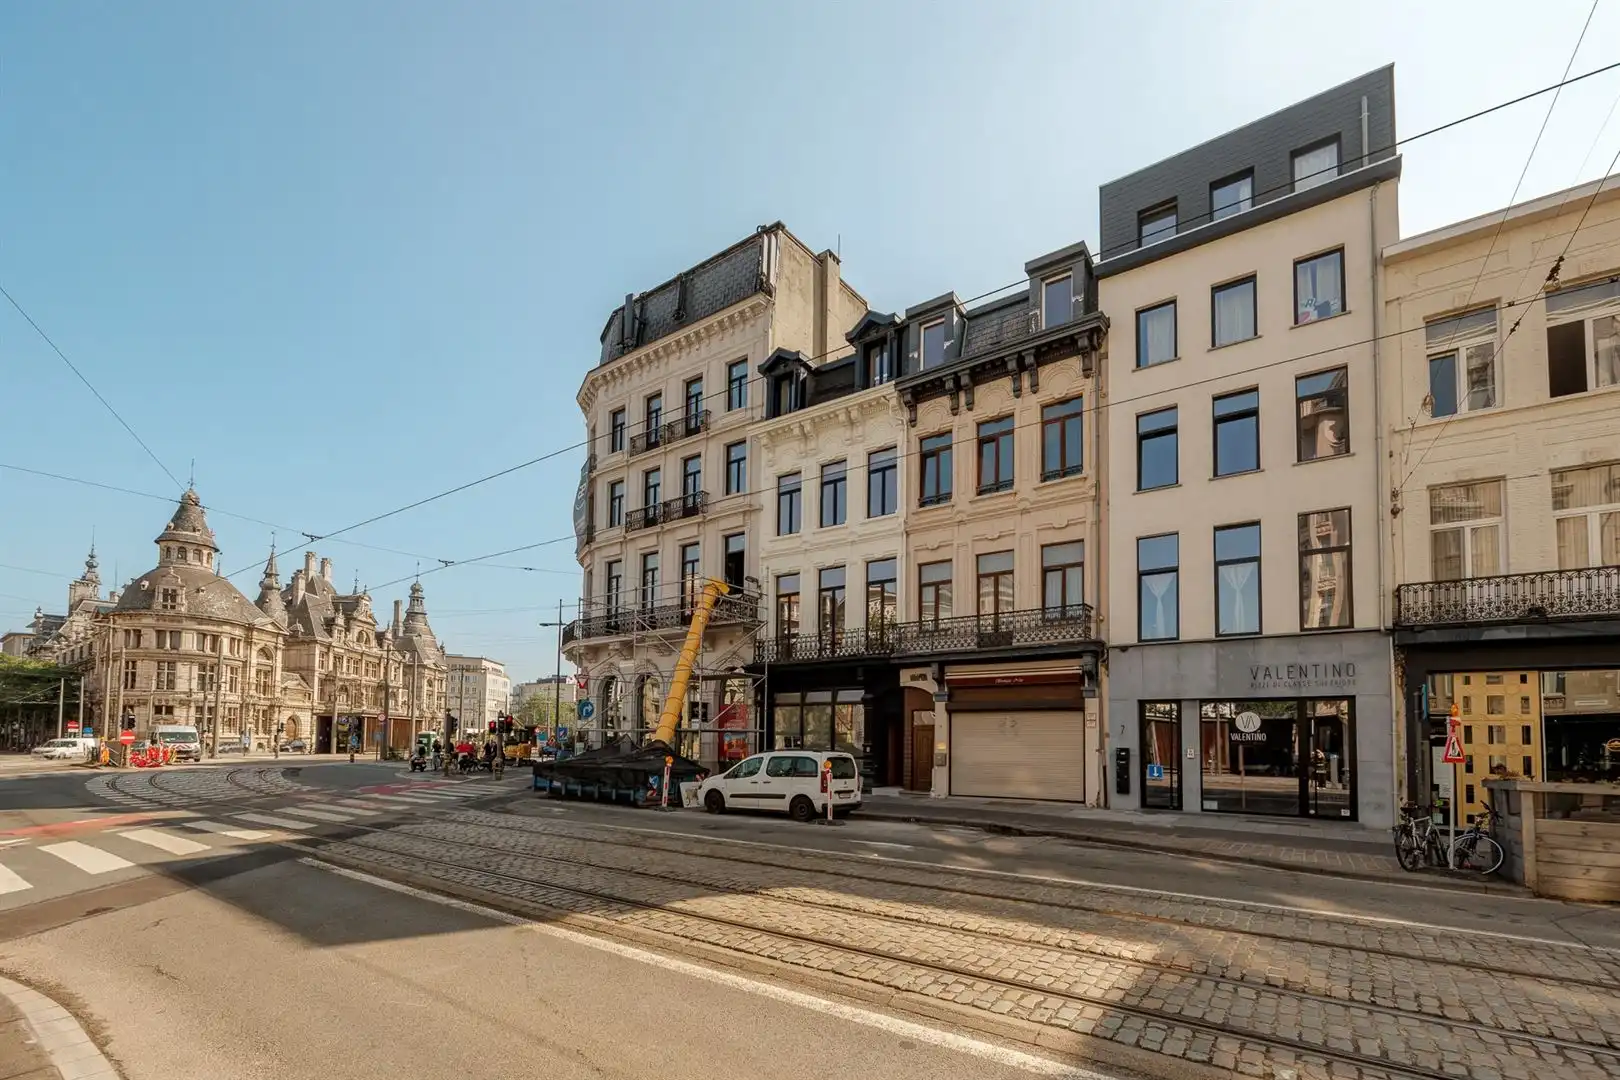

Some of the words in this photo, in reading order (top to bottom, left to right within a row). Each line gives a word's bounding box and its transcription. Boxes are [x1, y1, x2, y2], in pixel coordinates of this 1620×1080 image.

[1249, 662, 1356, 681] VALENTINO
[1240, 715, 1256, 729] VA
[1120, 724, 1126, 735] 7
